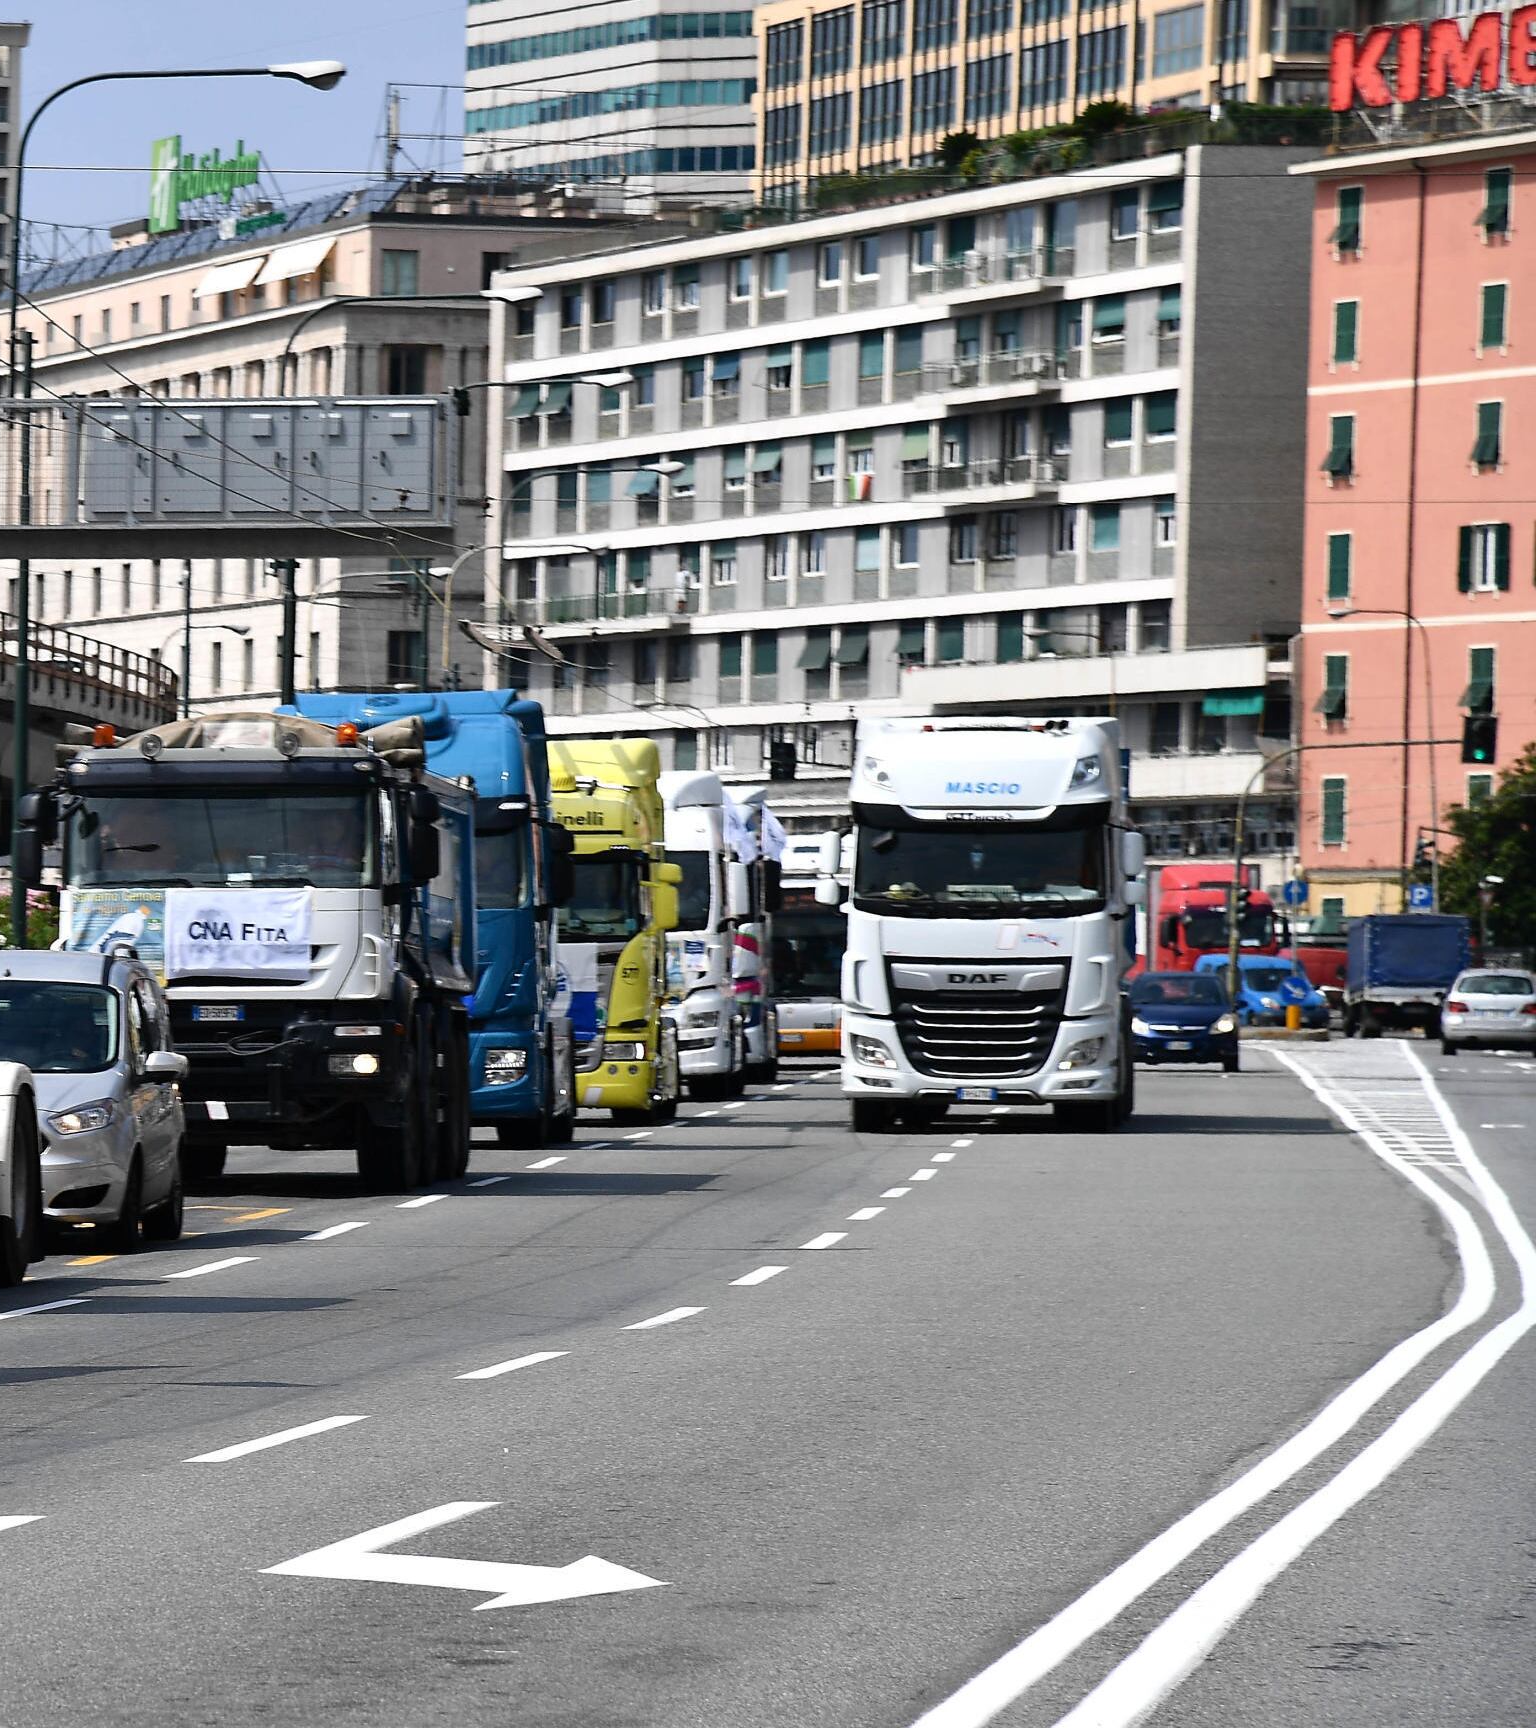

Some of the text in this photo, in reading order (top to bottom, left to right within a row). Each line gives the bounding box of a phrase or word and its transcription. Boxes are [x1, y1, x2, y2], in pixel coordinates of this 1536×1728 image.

[945, 782, 1021, 795] MASCIO
[188, 921, 233, 941] CNA
[946, 973, 1011, 985] DAF
